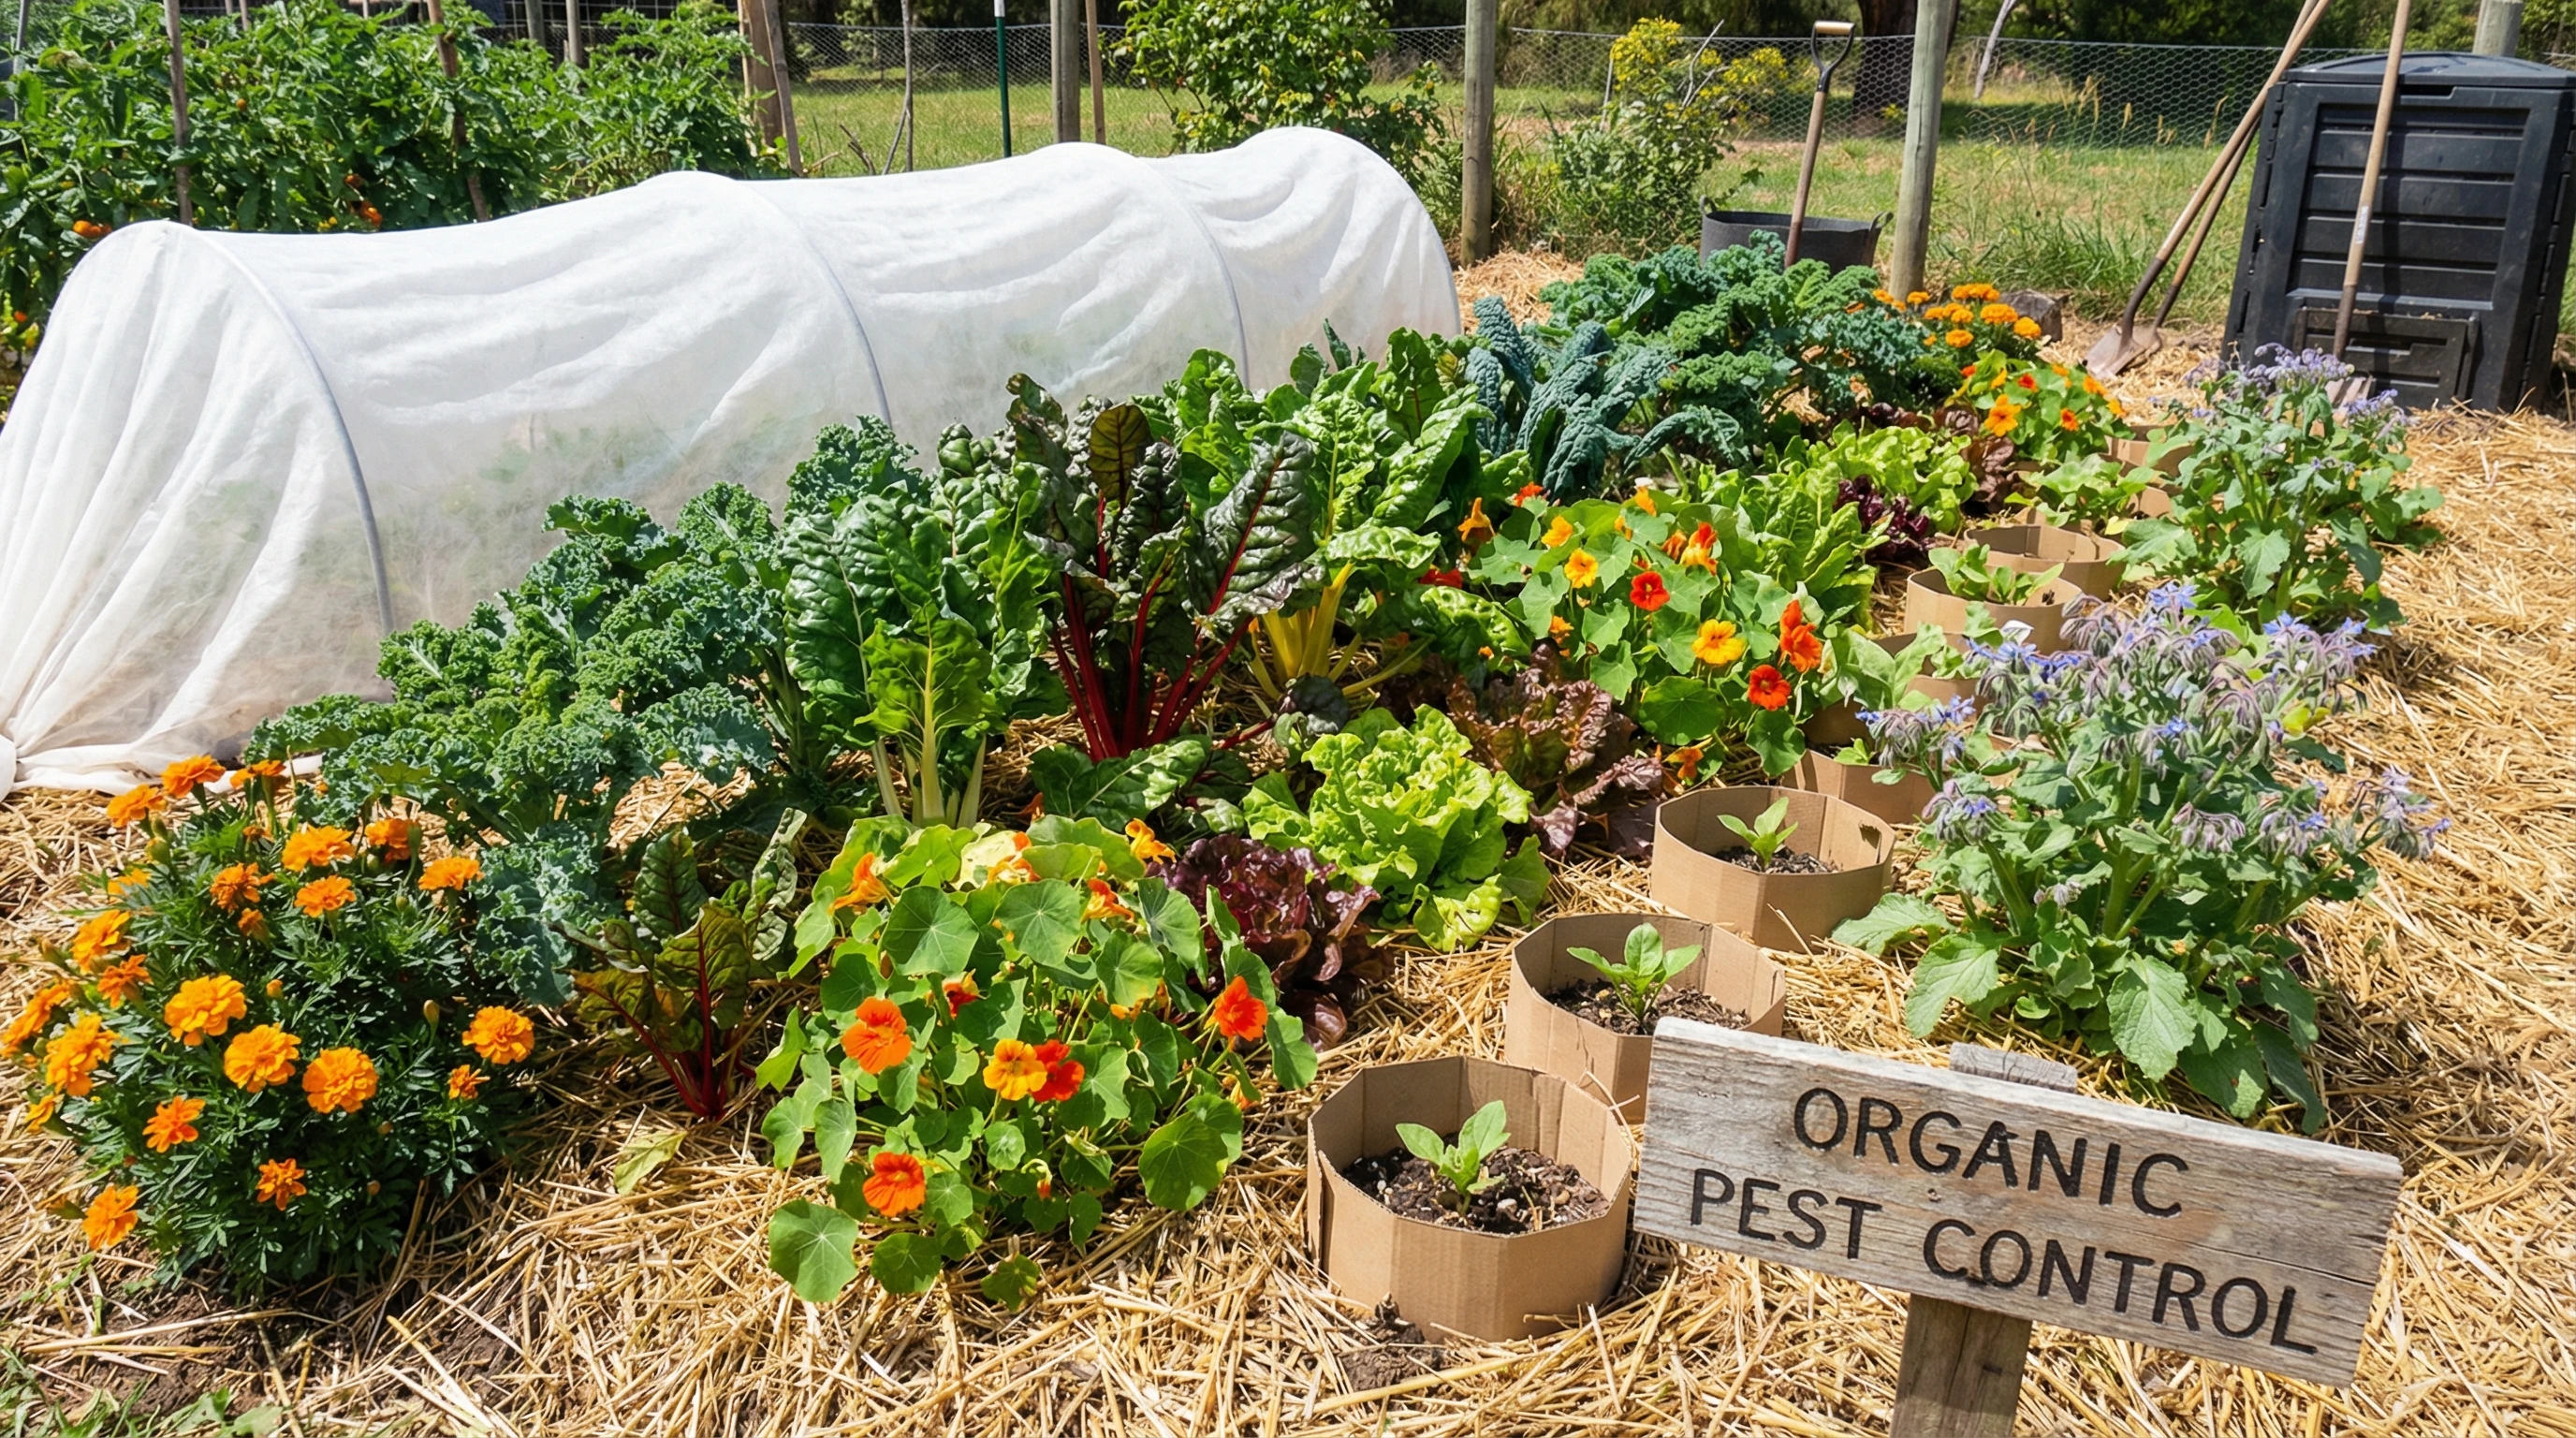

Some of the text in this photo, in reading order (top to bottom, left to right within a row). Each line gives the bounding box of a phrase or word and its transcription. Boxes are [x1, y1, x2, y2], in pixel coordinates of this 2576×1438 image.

[1793, 1087, 2189, 1218] ORGANIC
[1690, 1167, 2318, 1354] PEST CONTROL
